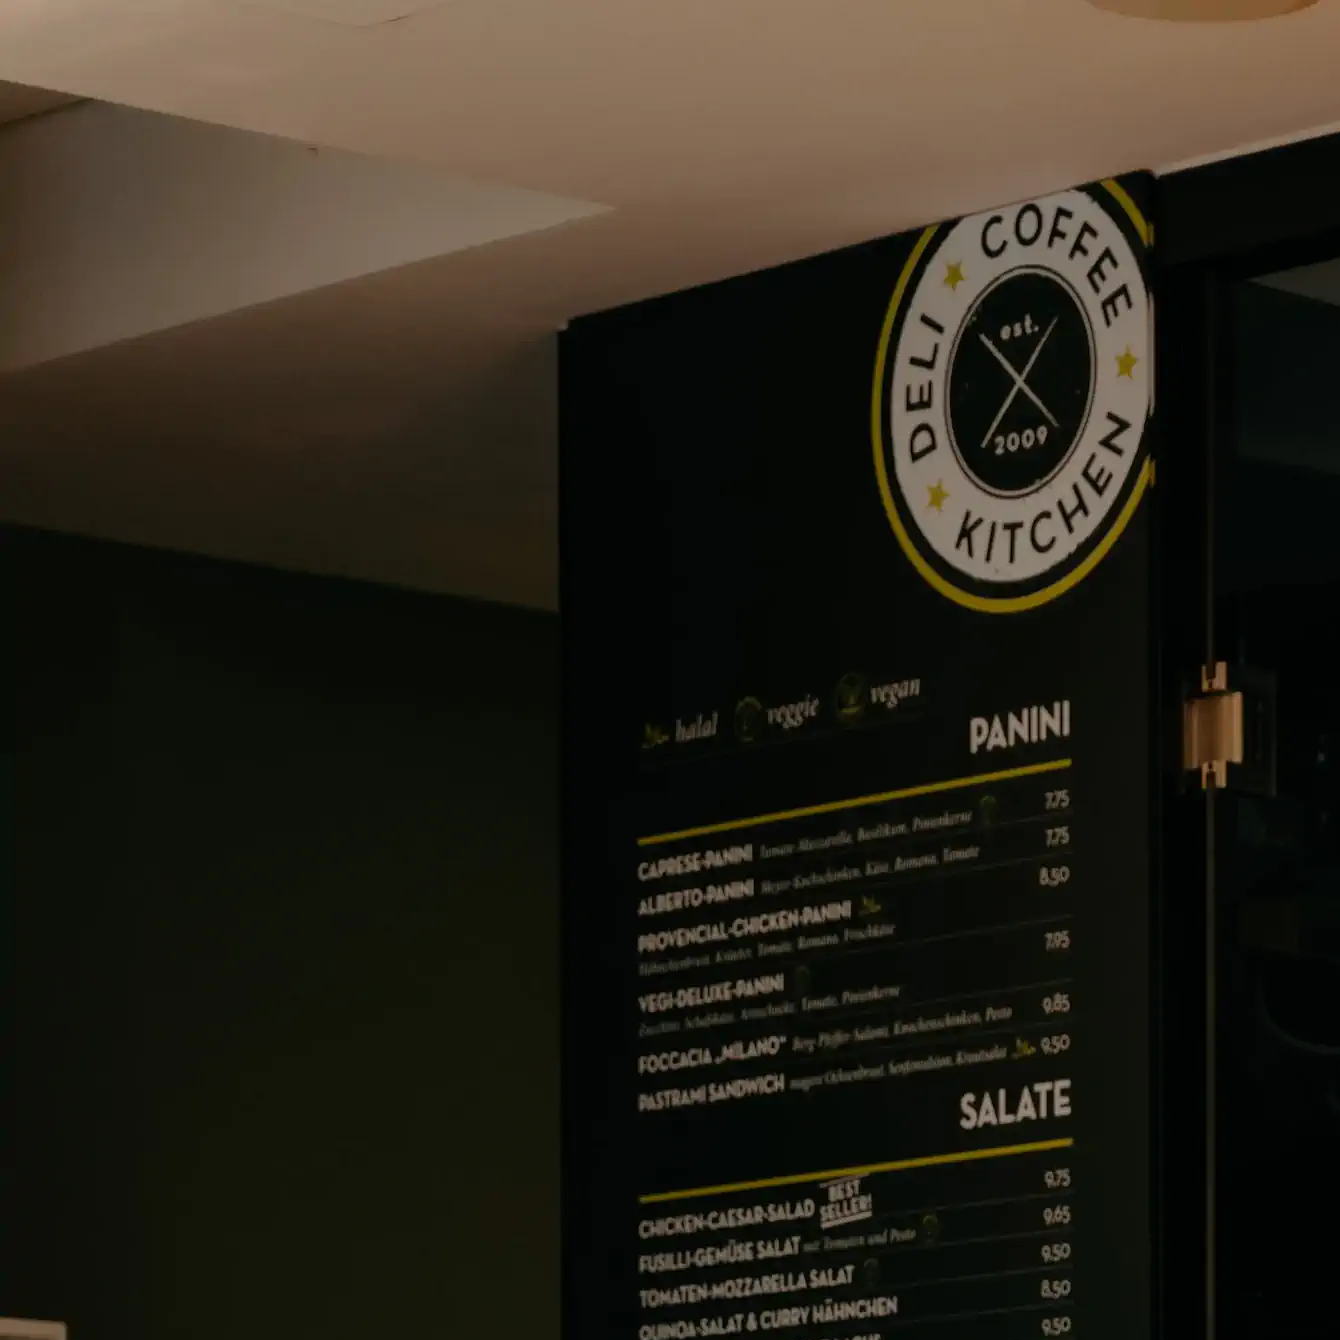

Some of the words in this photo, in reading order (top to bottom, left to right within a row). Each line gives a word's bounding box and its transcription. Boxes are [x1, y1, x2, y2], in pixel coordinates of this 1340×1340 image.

[980, 203, 1134, 328] COFFEE
[1000, 312, 1040, 342] est.
[905, 313, 945, 463] DELI
[994, 425, 1049, 457] 2009
[954, 411, 1132, 564] KITCHEN
[768, 694, 820, 731] veggie
[871, 678, 921, 709] vegan
[675, 712, 719, 743] halal
[969, 700, 1071, 754] PANINI
[638, 843, 754, 883] CAPRESE-PANINI
[638, 877, 755, 917] ALBERTO-PANINI
[638, 900, 852, 954] PROVENCIAL-CHICKEN-PANINI
[638, 972, 784, 1015] VEGI-DELUXE-PANINI
[638, 1046, 713, 1077] FOCCACIA
[638, 1086, 708, 1113] PASTRAMI
[709, 1073, 785, 1103] SANDWICH
[958, 1078, 1072, 1132] SALATE
[828, 1179, 861, 1201] BEST
[638, 1198, 816, 1240] CHICKEN-CAESAR-SALAD
[638, 1238, 754, 1274] FUSILLI-GEMÜSE
[756, 1235, 802, 1264] SALAT
[638, 1268, 808, 1309] TOMATEN-MOZZARELLA
[809, 1264, 855, 1292] SALAT
[760, 1304, 811, 1335] CURRY
[812, 1294, 899, 1329] HÄHNCHEN
